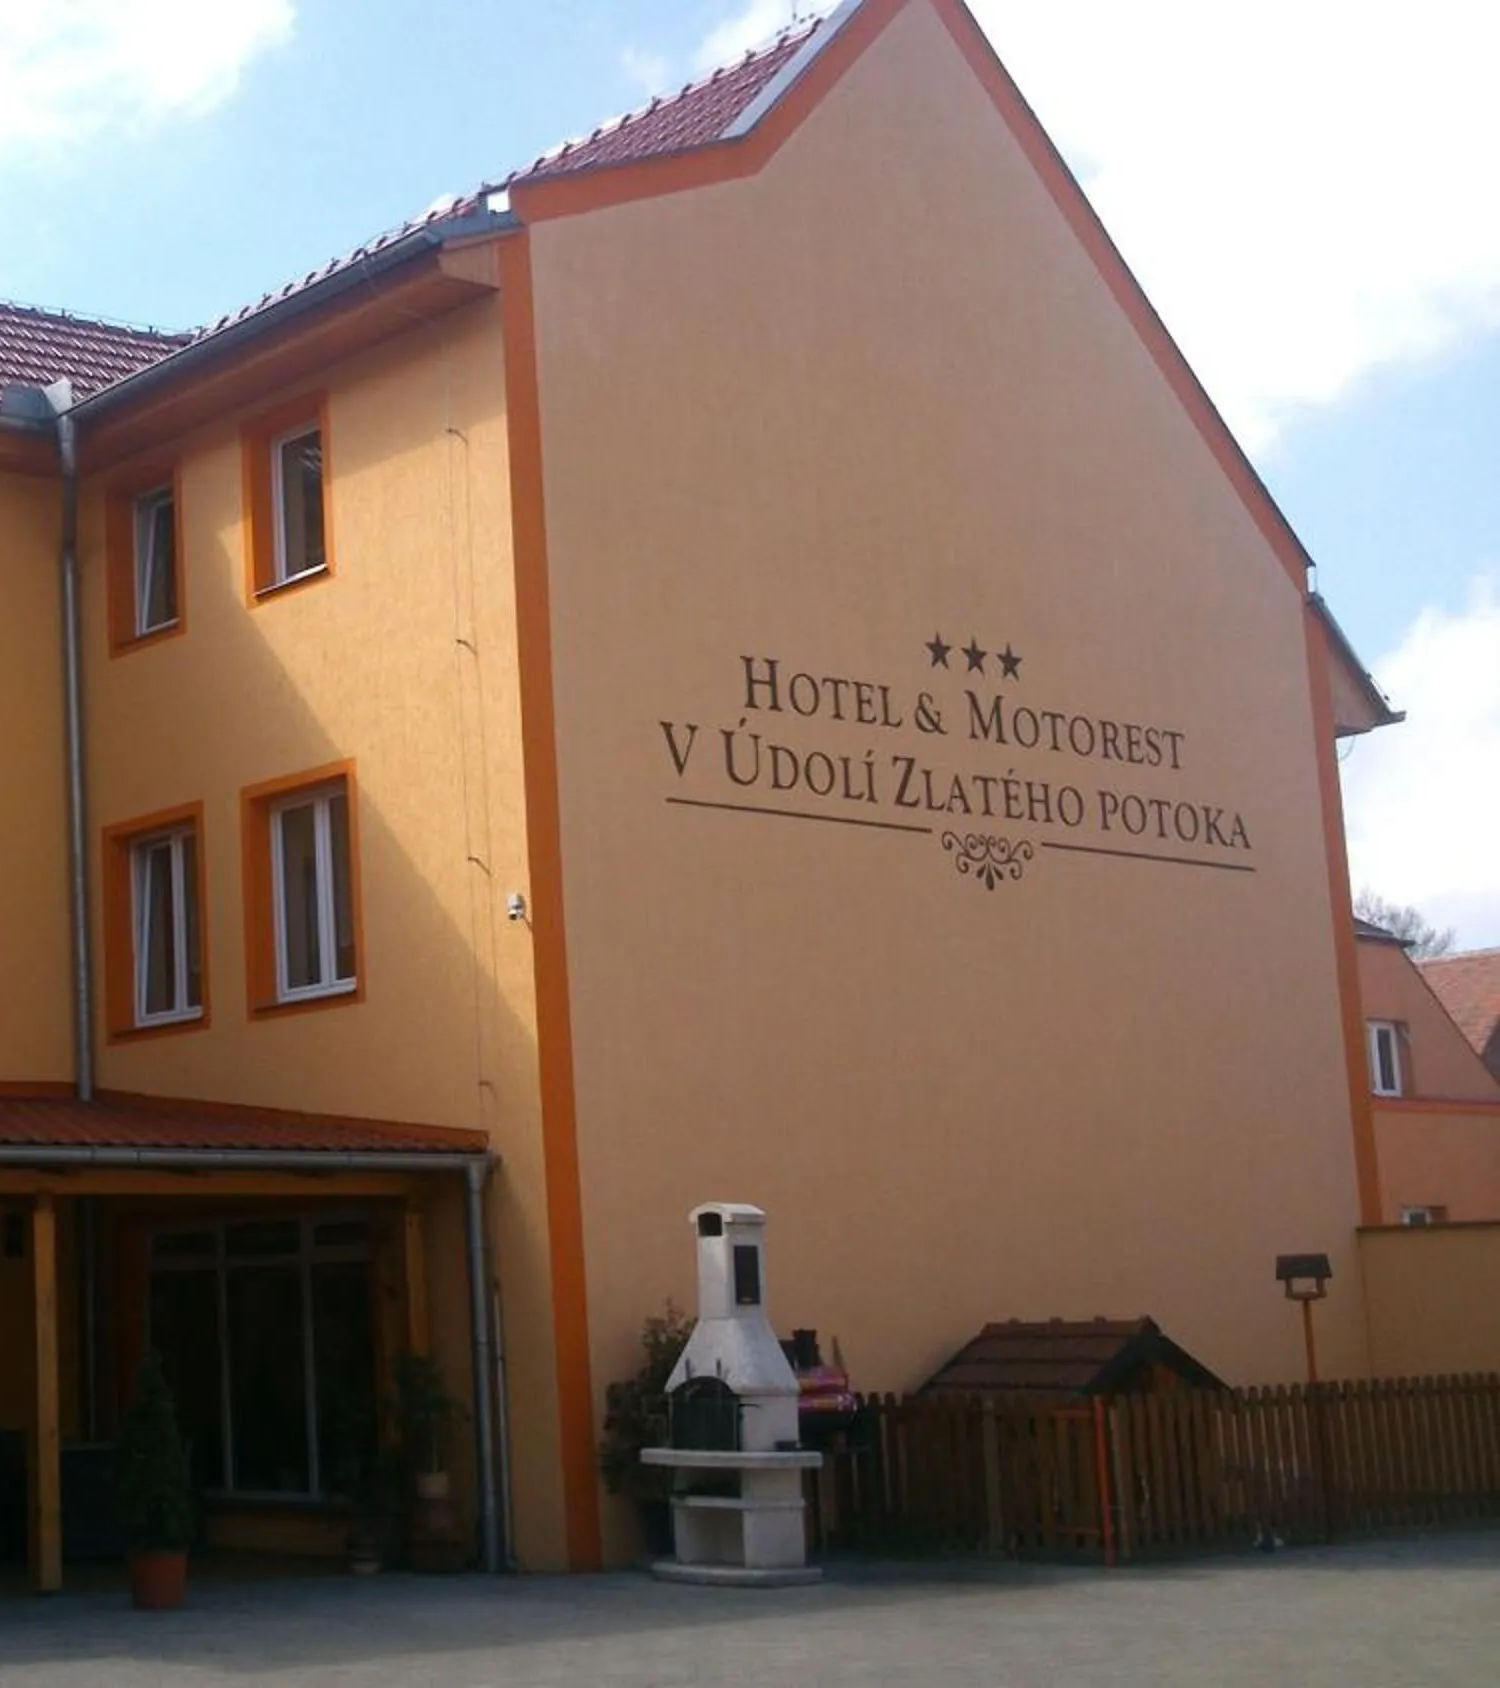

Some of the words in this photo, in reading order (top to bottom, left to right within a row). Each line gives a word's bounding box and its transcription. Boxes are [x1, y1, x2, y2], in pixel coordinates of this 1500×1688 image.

[739, 655, 903, 729] HOTEL
[914, 692, 948, 736] &
[964, 689, 1186, 770] MOTOREST
[659, 720, 699, 777] V
[720, 716, 879, 804] ÚDOLÍ
[892, 755, 1085, 828] ZLATÉHO
[1097, 790, 1253, 850] POTOKA
